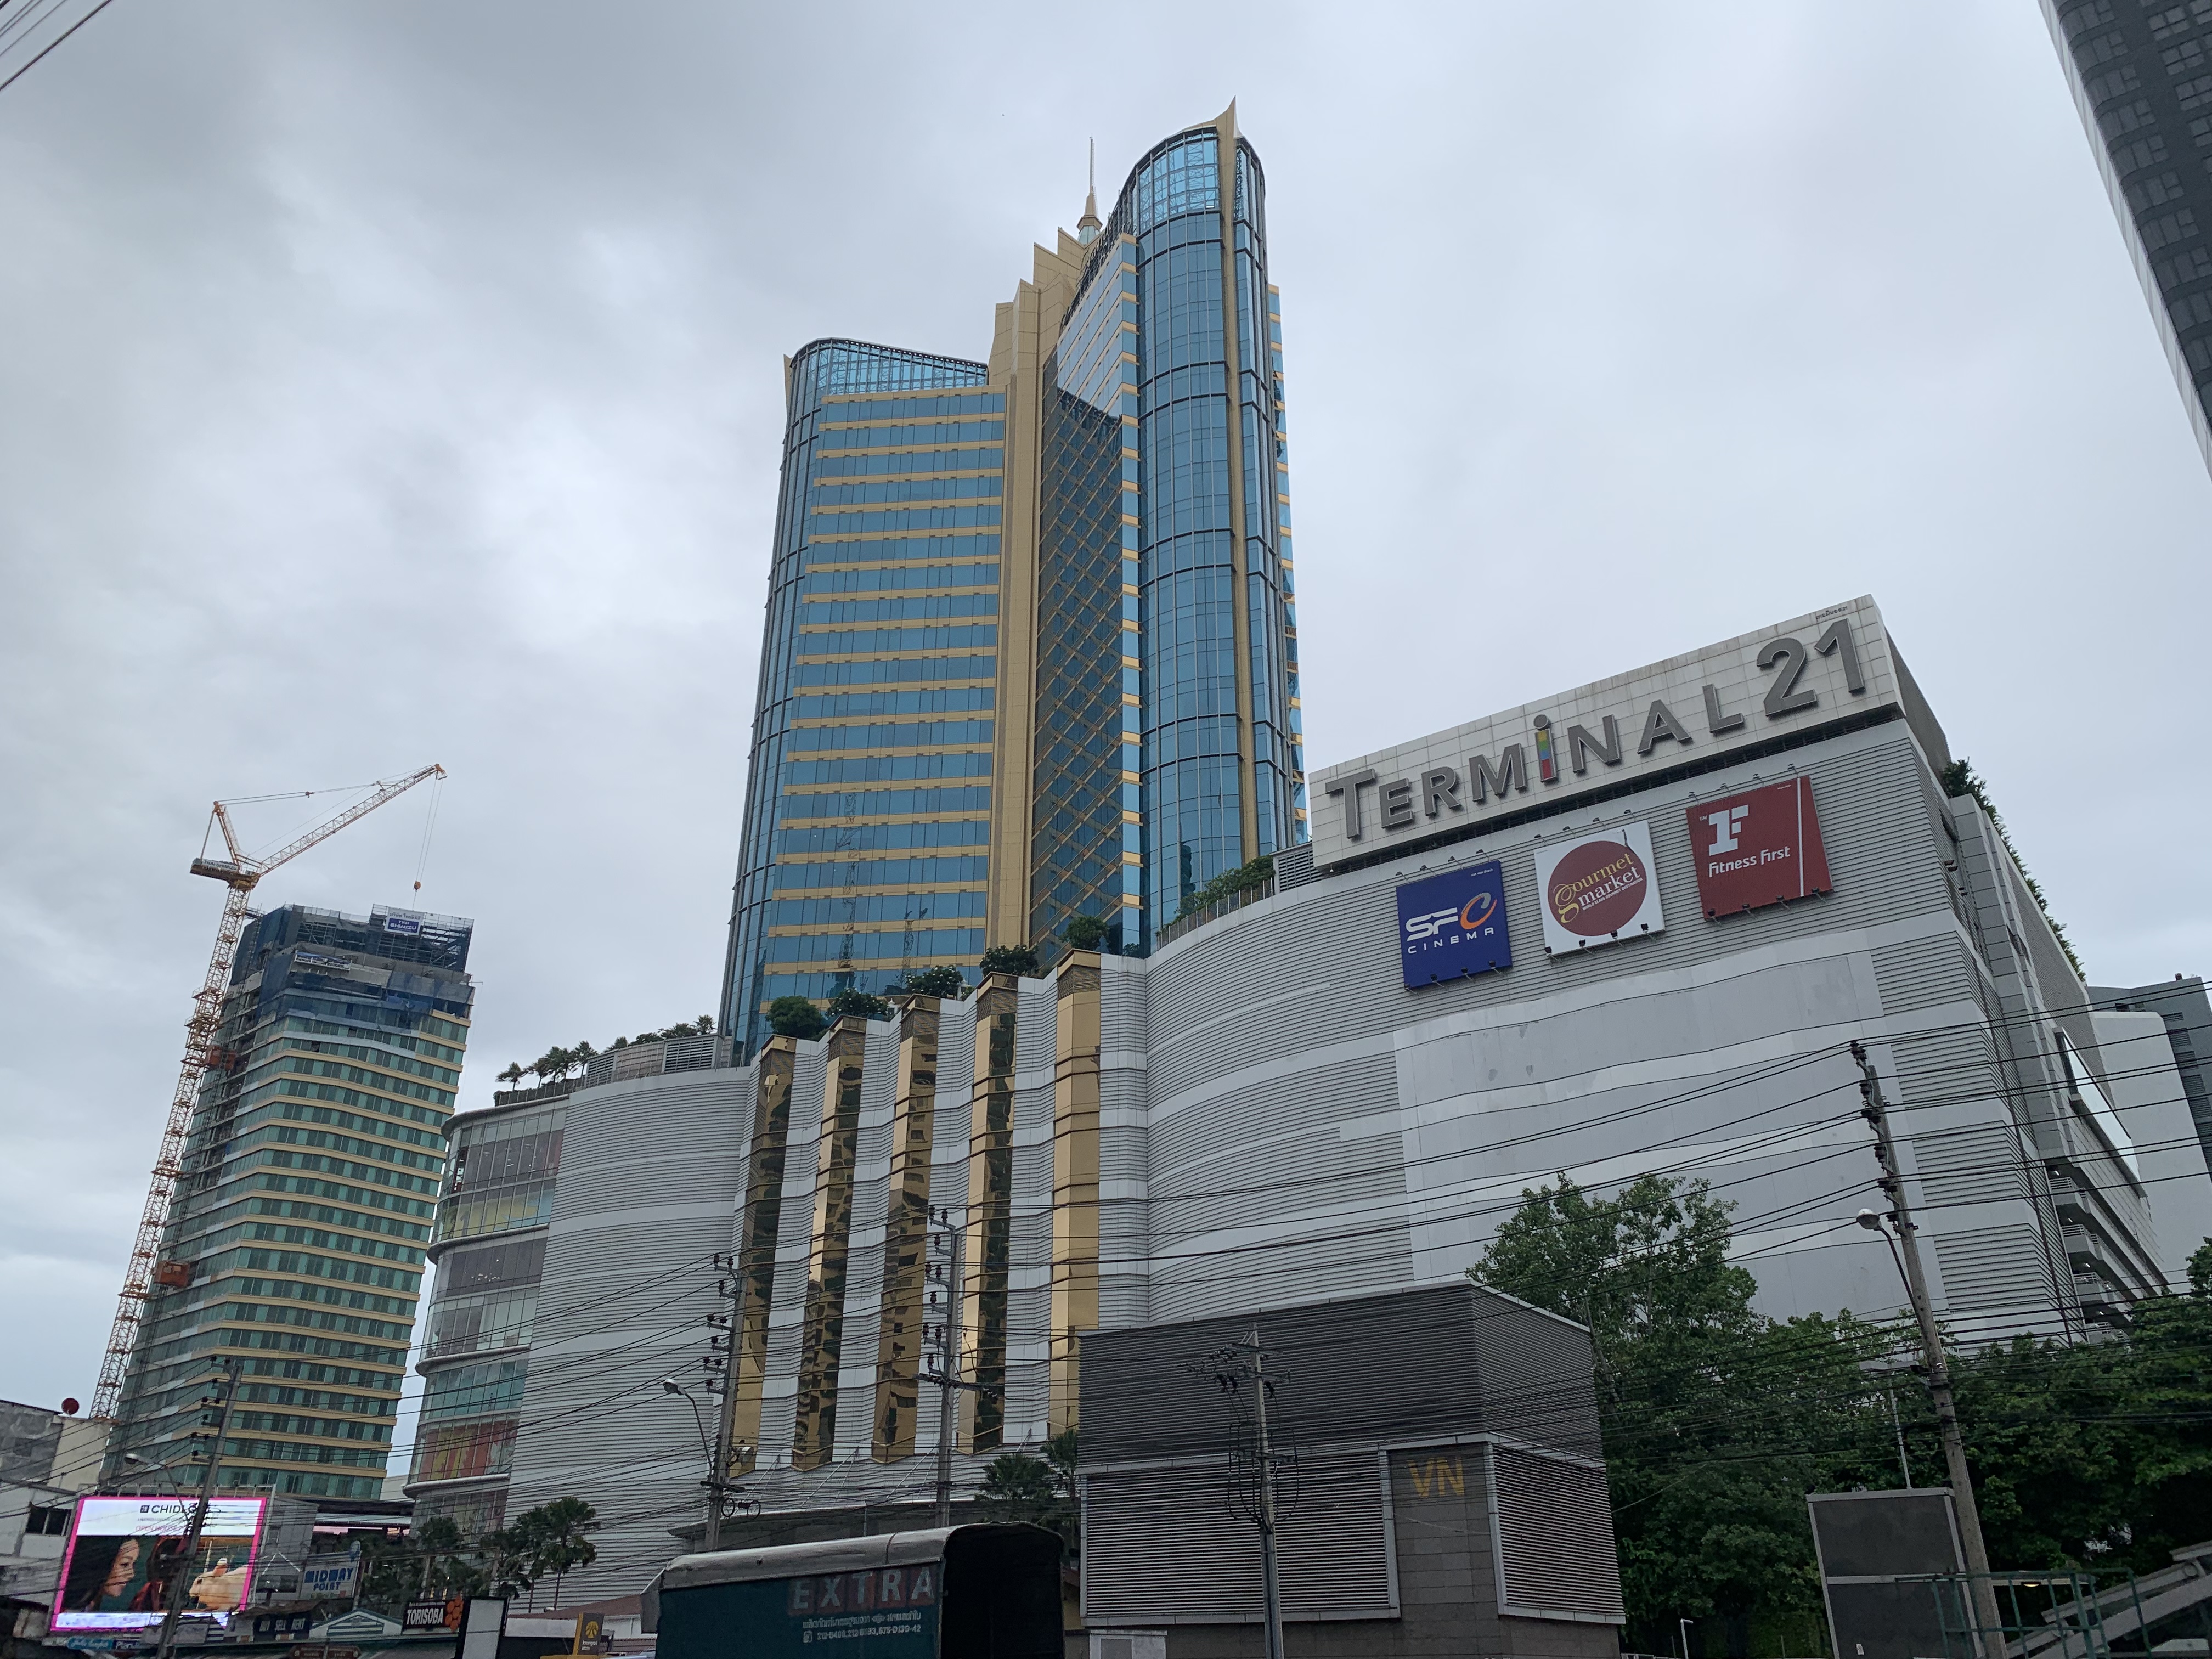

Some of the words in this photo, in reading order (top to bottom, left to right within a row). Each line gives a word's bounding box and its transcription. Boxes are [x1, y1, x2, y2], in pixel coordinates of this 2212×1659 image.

[1757, 618, 1865, 716] 21
[1709, 856, 1757, 877] Fitness
[1760, 846, 1790, 865] First
[1578, 866, 1641, 907] market
[1407, 927, 1494, 954] CINEMA
[1406, 1457, 1465, 1497] VN
[313, 1582, 341, 1591] POINT
[794, 1566, 933, 1609] EXTRA
[407, 1607, 444, 1625] TORISOBA
